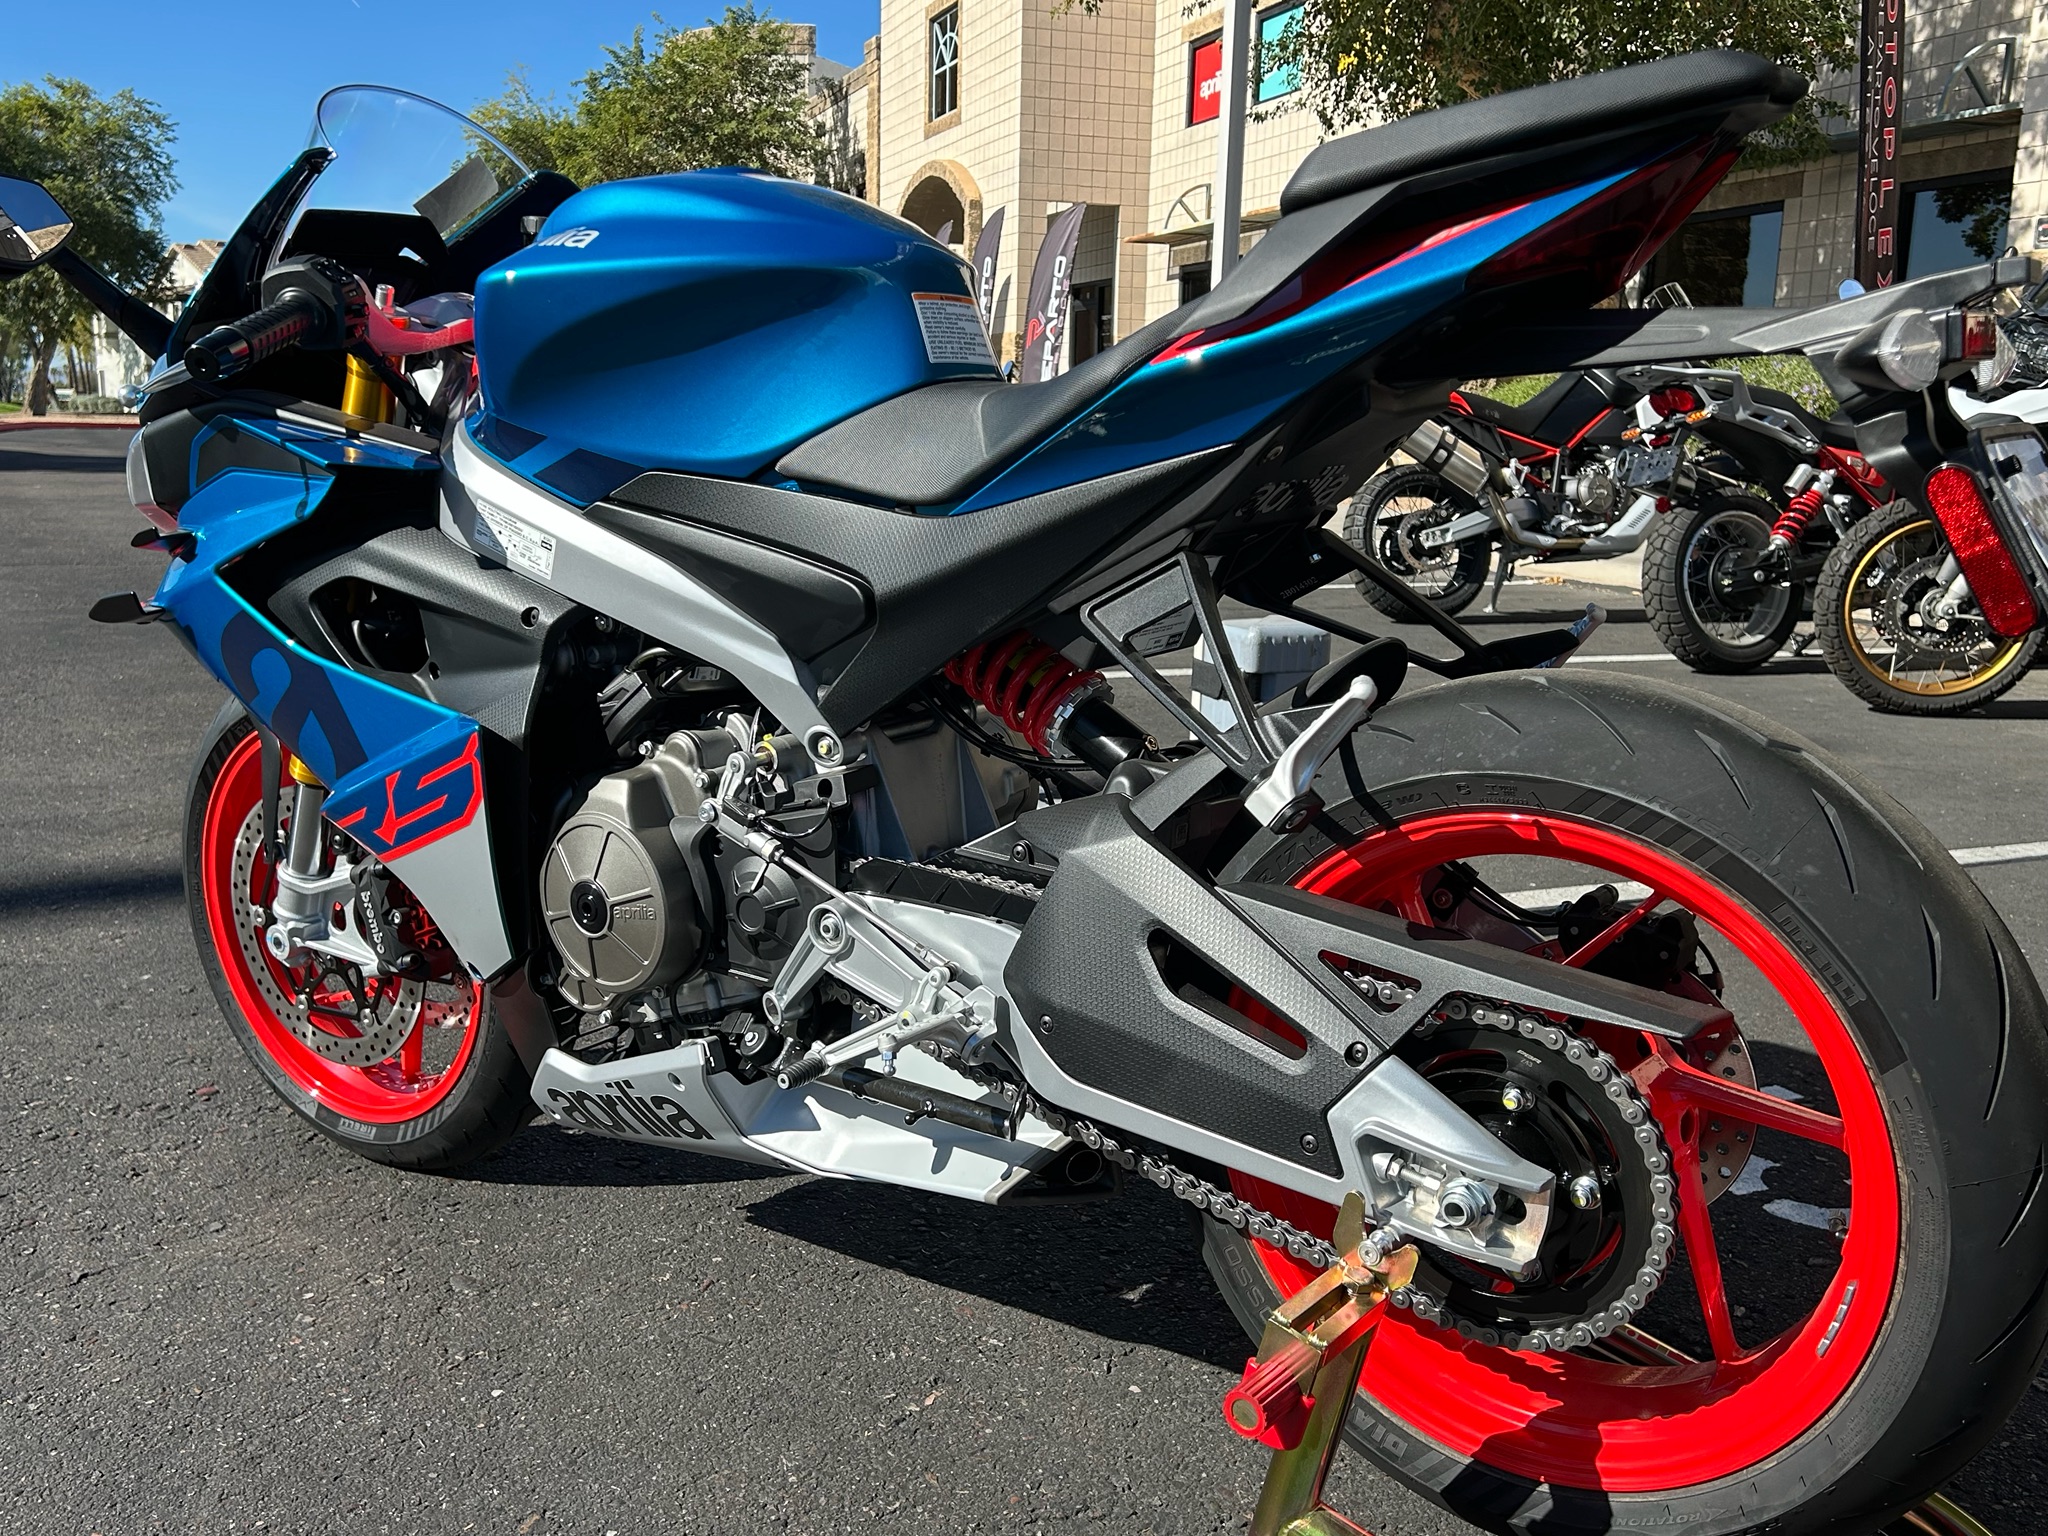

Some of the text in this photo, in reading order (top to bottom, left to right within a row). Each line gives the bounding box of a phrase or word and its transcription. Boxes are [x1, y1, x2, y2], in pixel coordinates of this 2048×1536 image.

[537, 226, 600, 249] ilia
[1040, 255, 1067, 382] EPARTO
[360, 890, 386, 955] brembo
[613, 903, 657, 923] aprilia
[547, 1079, 716, 1142] aprilia
[1353, 1408, 1409, 1458] DIA
[1616, 1512, 1701, 1526] ROTATION
